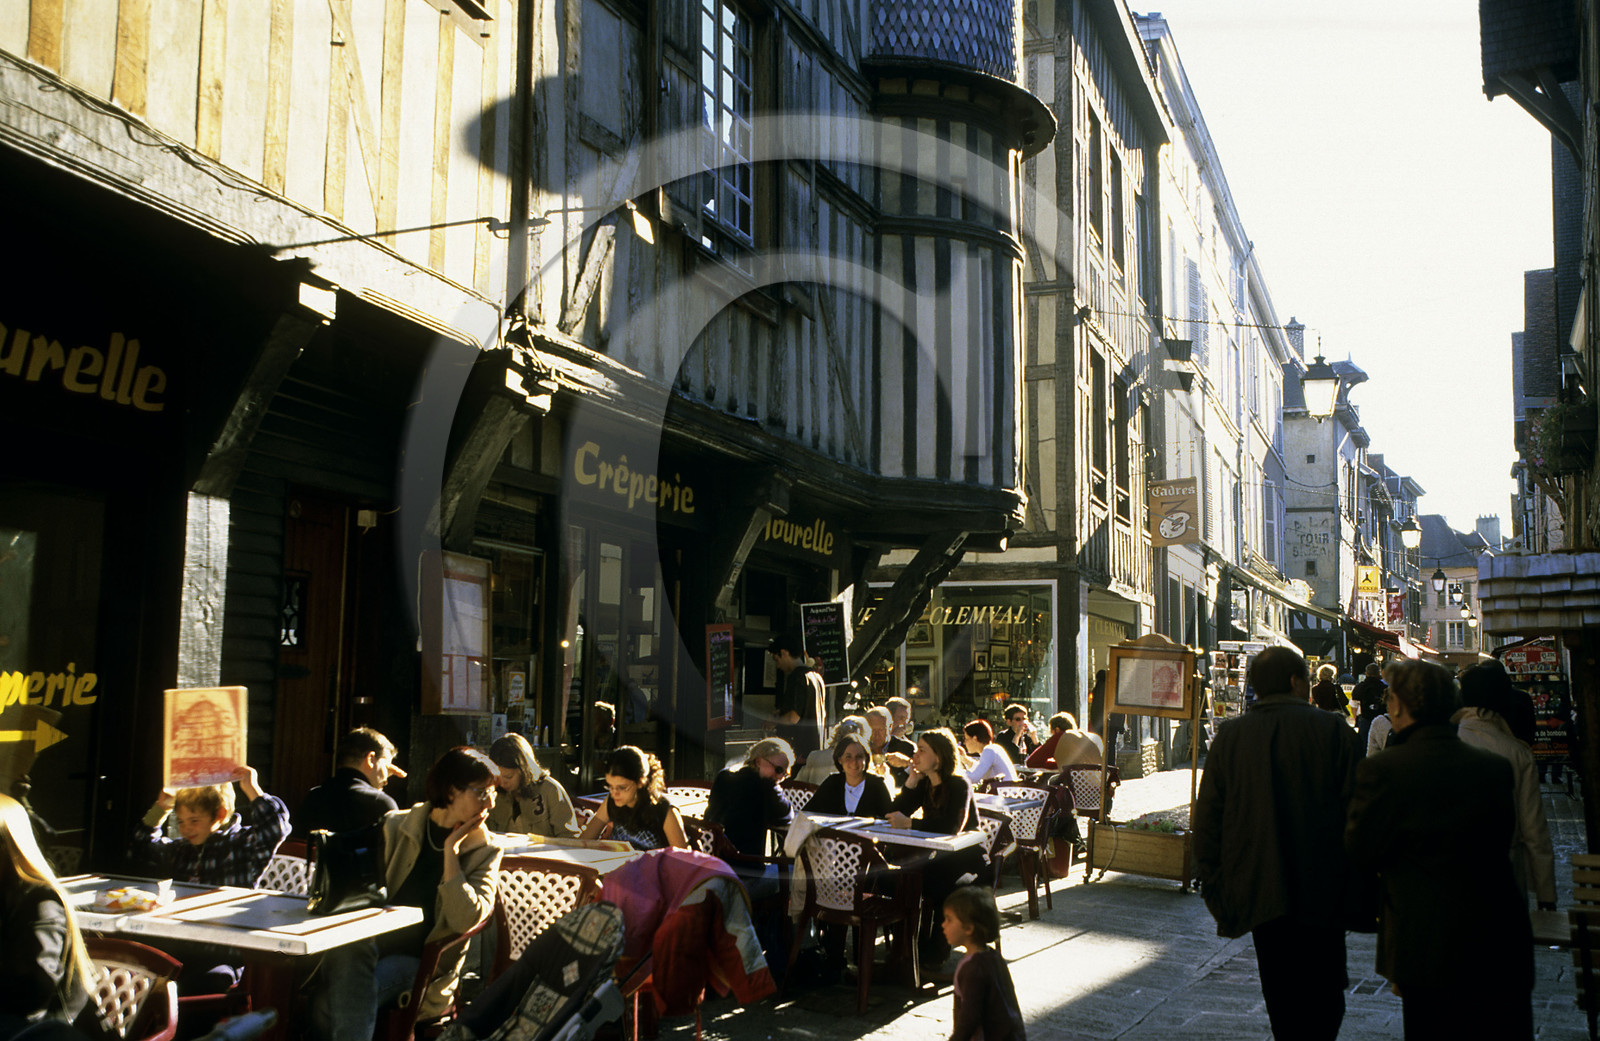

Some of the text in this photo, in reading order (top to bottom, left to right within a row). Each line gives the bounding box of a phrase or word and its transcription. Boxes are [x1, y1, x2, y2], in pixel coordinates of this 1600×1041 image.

[574, 441, 695, 514] Crêperie
[1152, 485, 1196, 498] Cadres
[1297, 532, 1330, 545] TOUR
[929, 605, 1028, 625] CLEMVAL
[532, 792, 545, 816] 3
